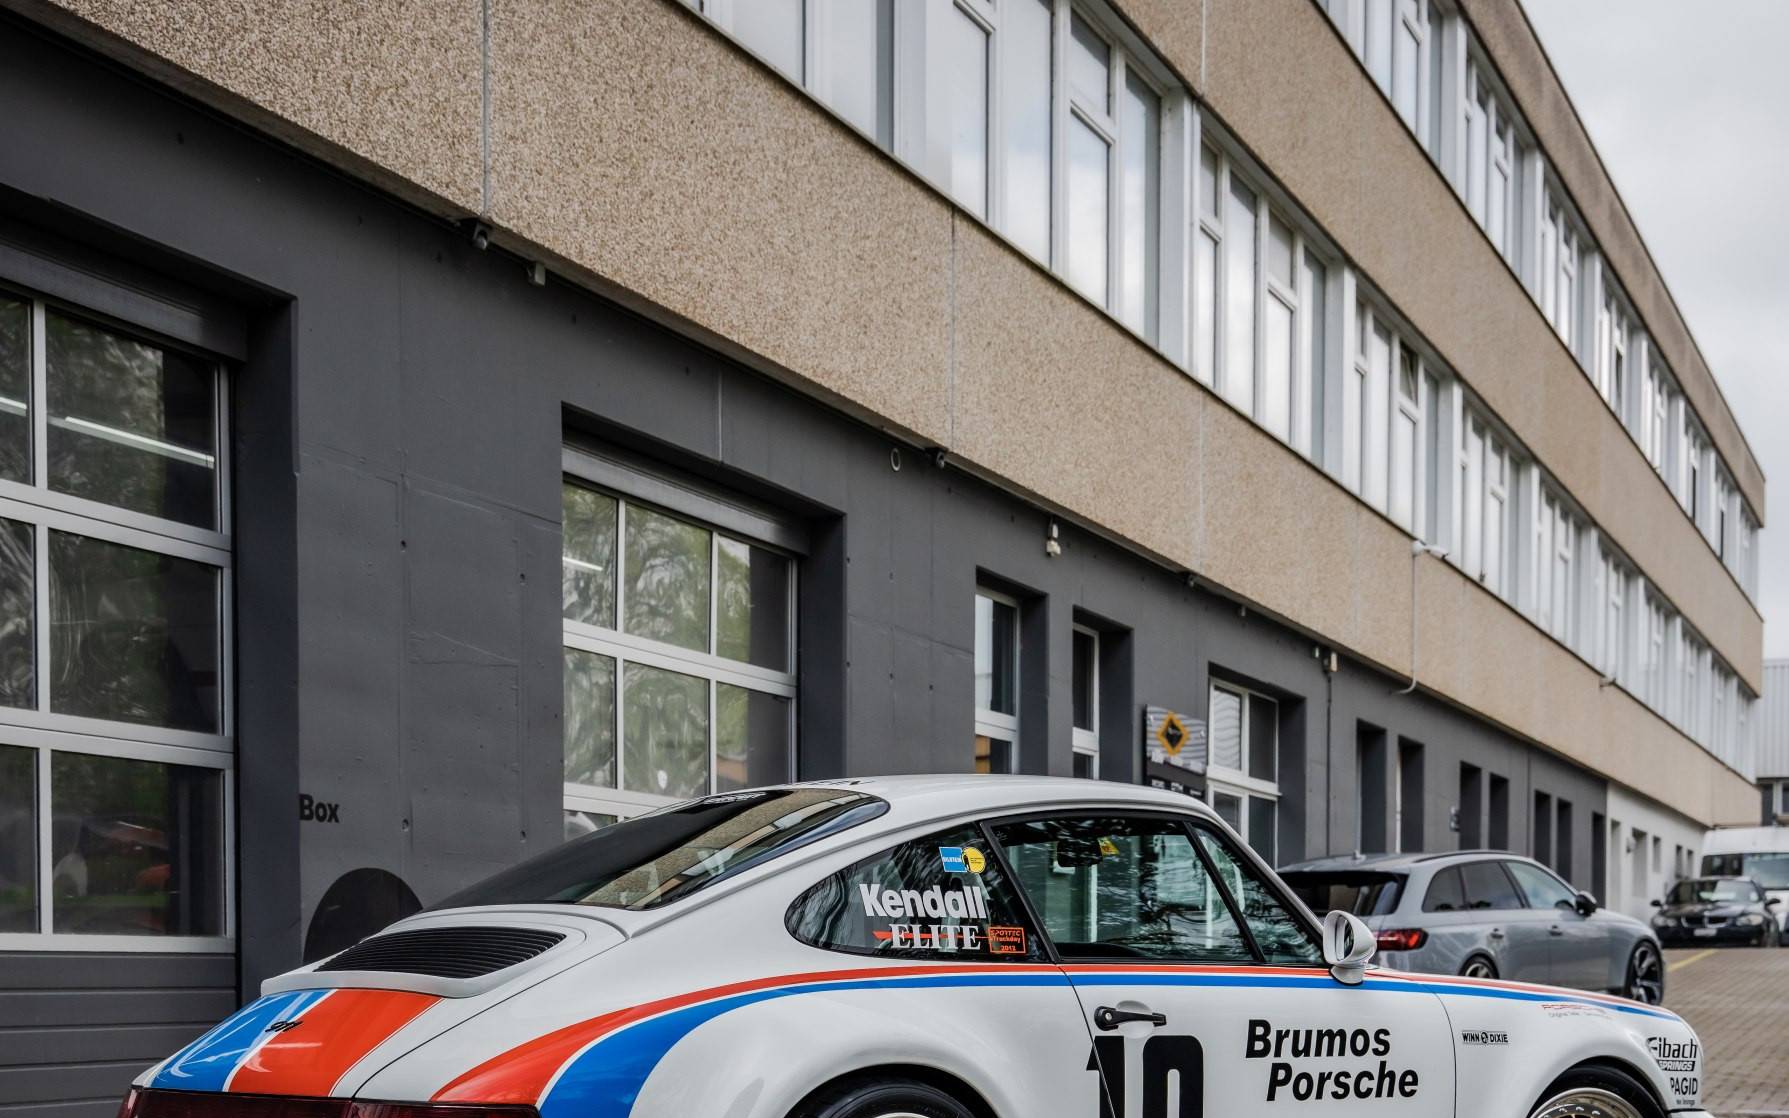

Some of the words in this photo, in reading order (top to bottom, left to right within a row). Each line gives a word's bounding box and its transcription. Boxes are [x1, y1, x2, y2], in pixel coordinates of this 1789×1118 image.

[299, 793, 339, 823] Box
[859, 883, 987, 919] Kendall
[888, 924, 981, 950] ELITE
[1245, 1018, 1391, 1059] Brumos
[1462, 1032, 1480, 1043] WINN
[1490, 1032, 1509, 1043] DIXIE
[1266, 1061, 1419, 1101] Porsche
[1670, 1077, 1698, 1096] PAGID
